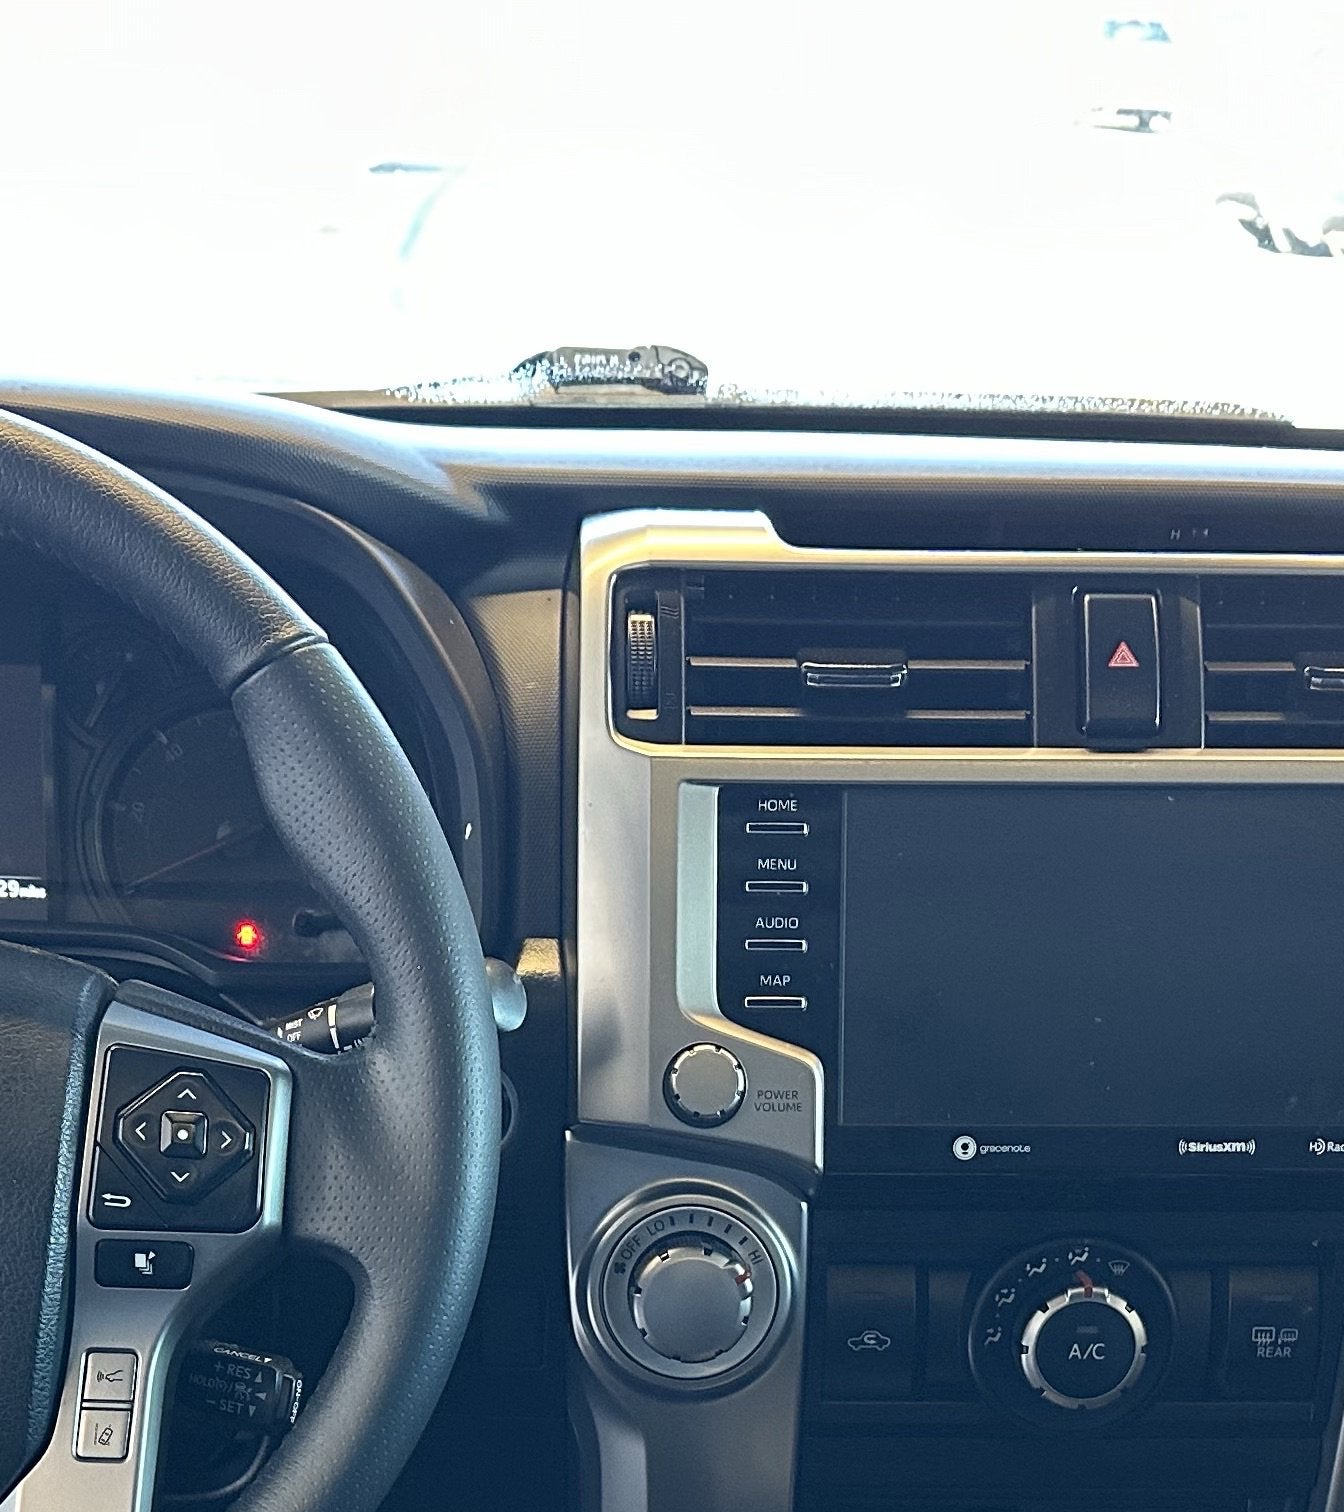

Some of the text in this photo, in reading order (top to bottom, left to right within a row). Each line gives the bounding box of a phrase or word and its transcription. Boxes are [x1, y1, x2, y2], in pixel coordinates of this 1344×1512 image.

[758, 799, 798, 812] HOME
[757, 858, 797, 871] MENU
[755, 917, 799, 929] AUDIO
[760, 975, 791, 987] MAP
[286, 1031, 302, 1043] OFF
[757, 1089, 799, 1100] POWER
[754, 1102, 803, 1113] VOLUME
[979, 1144, 1031, 1155] gracenote
[621, 1219, 665, 1261] OFF LO
[748, 1250, 764, 1265] HI
[213, 1347, 262, 1362] CANCEL
[1068, 1343, 1105, 1361] A/C
[1256, 1347, 1292, 1359] REAR
